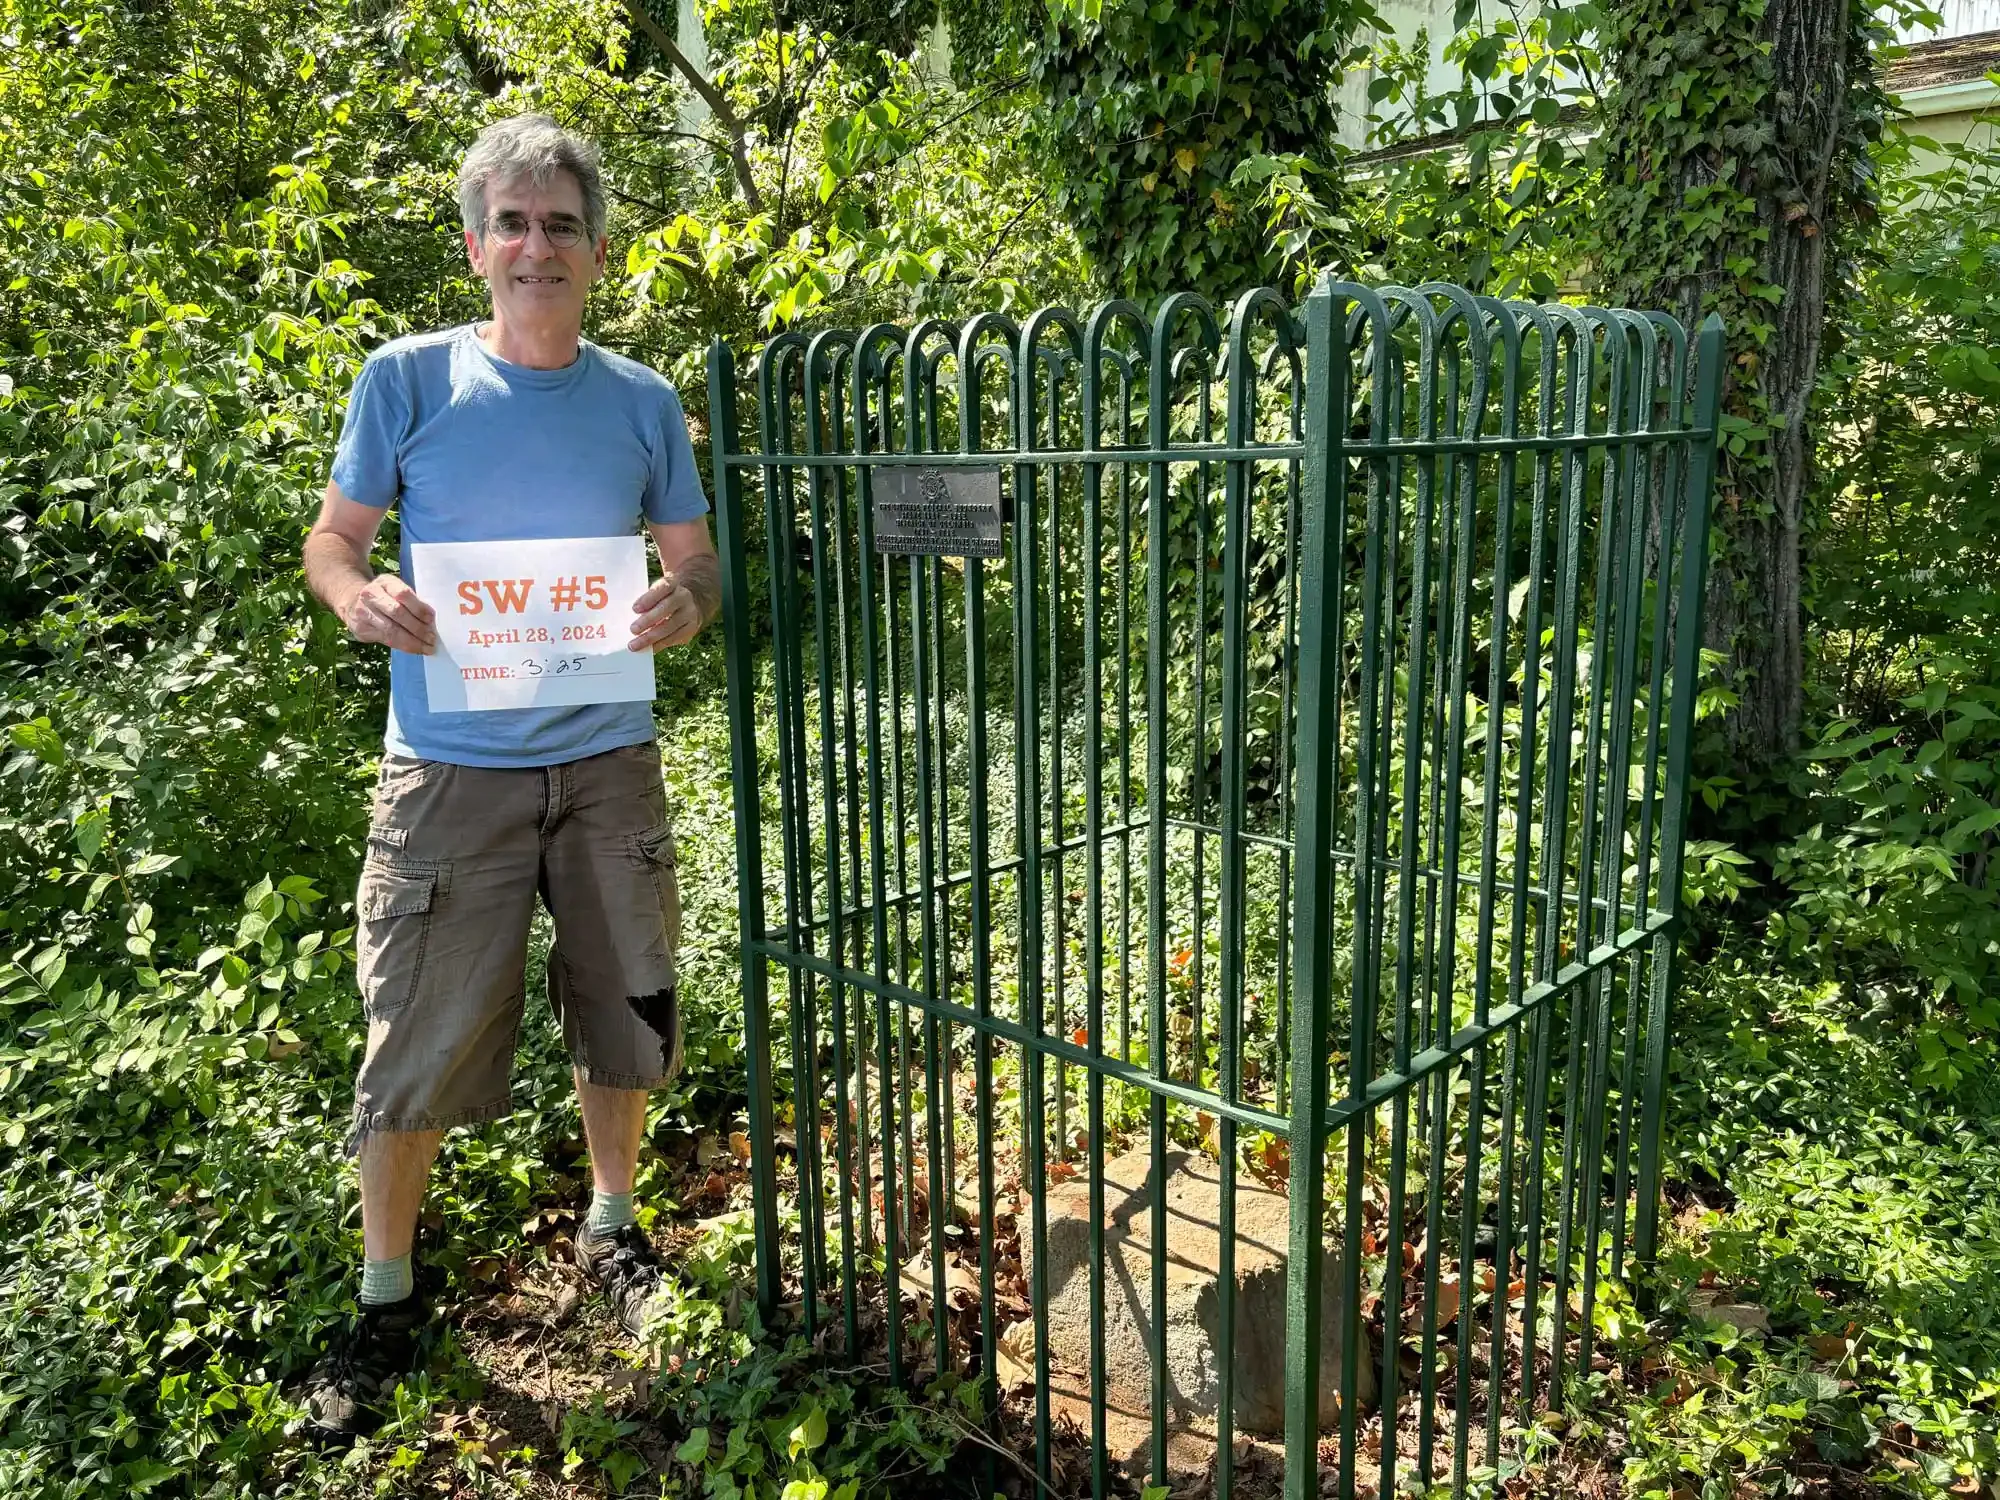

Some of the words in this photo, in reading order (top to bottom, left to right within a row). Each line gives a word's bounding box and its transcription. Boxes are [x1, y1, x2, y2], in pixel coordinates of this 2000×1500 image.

[457, 578, 535, 616] SW
[549, 575, 609, 612] #5
[468, 629, 521, 648] April
[526, 627, 556, 644] 28,
[562, 624, 607, 641] 2024
[461, 666, 516, 681] TIME:
